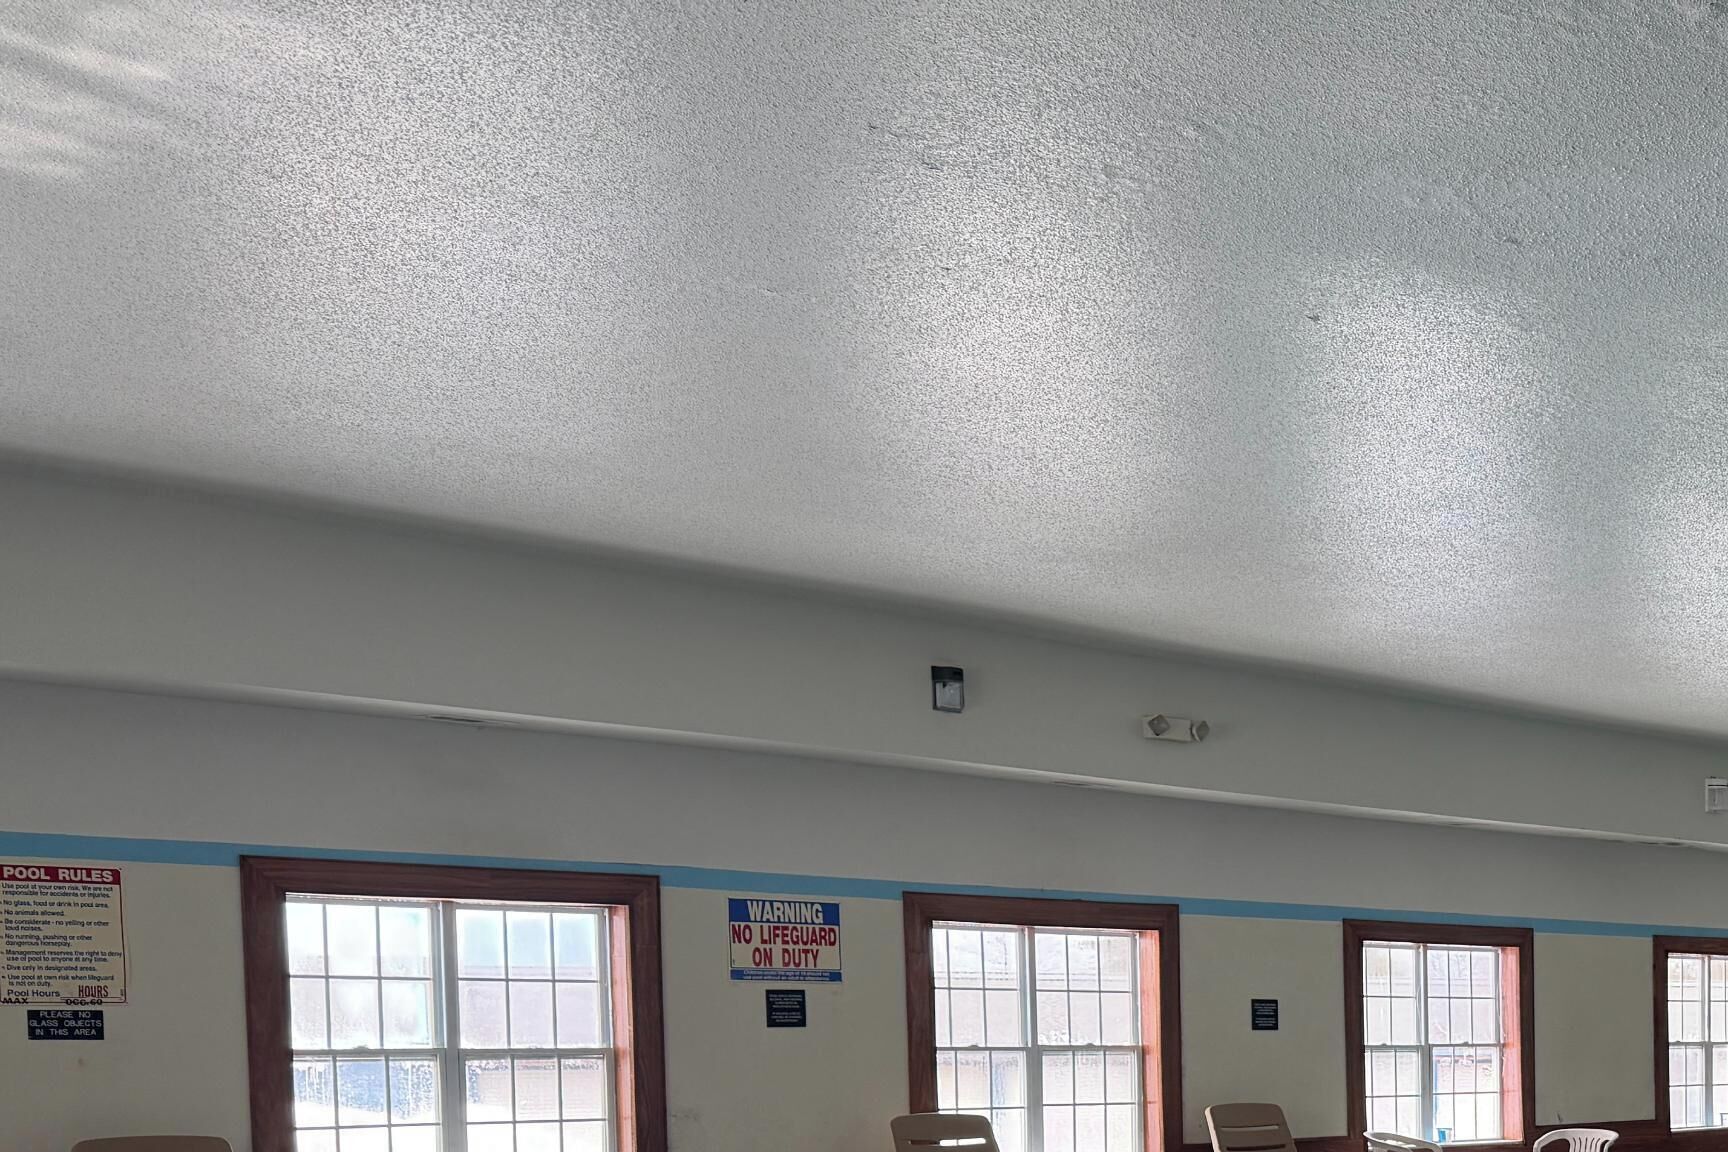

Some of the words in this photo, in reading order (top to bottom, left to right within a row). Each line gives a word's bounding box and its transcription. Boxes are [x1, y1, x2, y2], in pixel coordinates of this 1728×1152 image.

[2, 866, 50, 880] POOL
[58, 868, 113, 882] RULES
[747, 900, 824, 924] WARNING
[732, 924, 752, 944] NO
[760, 924, 837, 946] LIFEGUARD
[752, 947, 773, 967] ON
[782, 948, 820, 968] DUTY
[78, 985, 108, 998] HOURS
